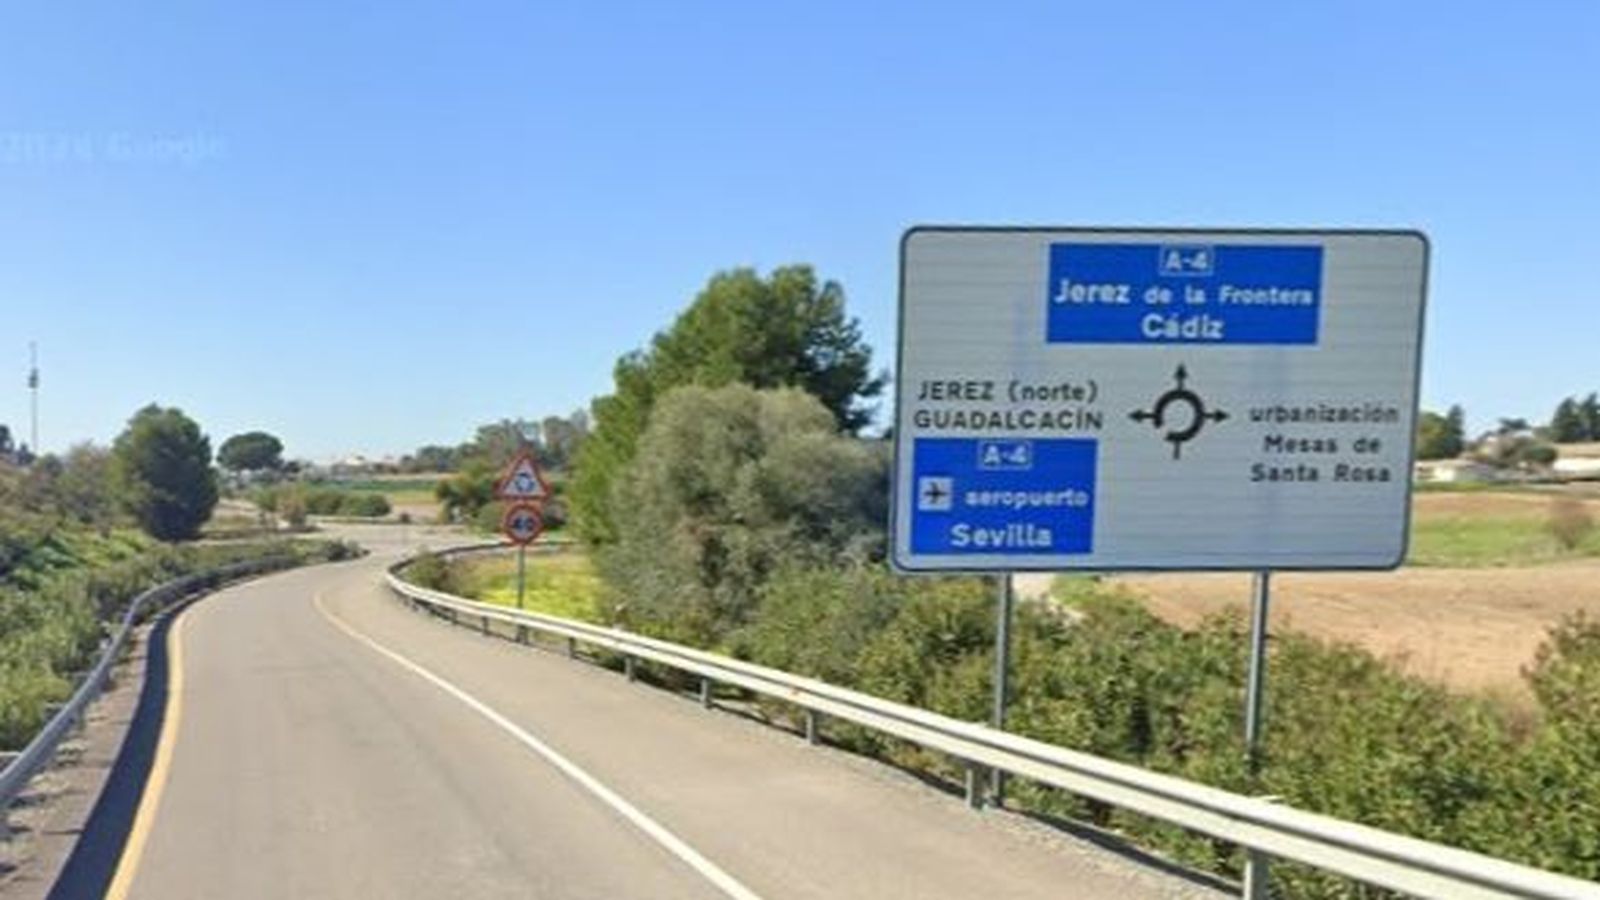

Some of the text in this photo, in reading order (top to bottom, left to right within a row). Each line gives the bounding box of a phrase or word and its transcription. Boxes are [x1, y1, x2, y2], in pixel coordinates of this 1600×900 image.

[1165, 250, 1209, 271] A-4
[1054, 278, 1314, 305] Jerez de la Frontera
[1141, 312, 1225, 339] Cádiz
[918, 380, 1099, 403] JEREZ (norte)
[914, 408, 1104, 430] GUADALCACÍN
[1250, 403, 1399, 423] urbanización
[1264, 434, 1382, 454] Mesas de
[983, 445, 1028, 465] A-4
[1251, 463, 1392, 483] Santa Rosa
[965, 489, 1090, 510] aeropuerto
[951, 523, 1052, 548] Sevilla
